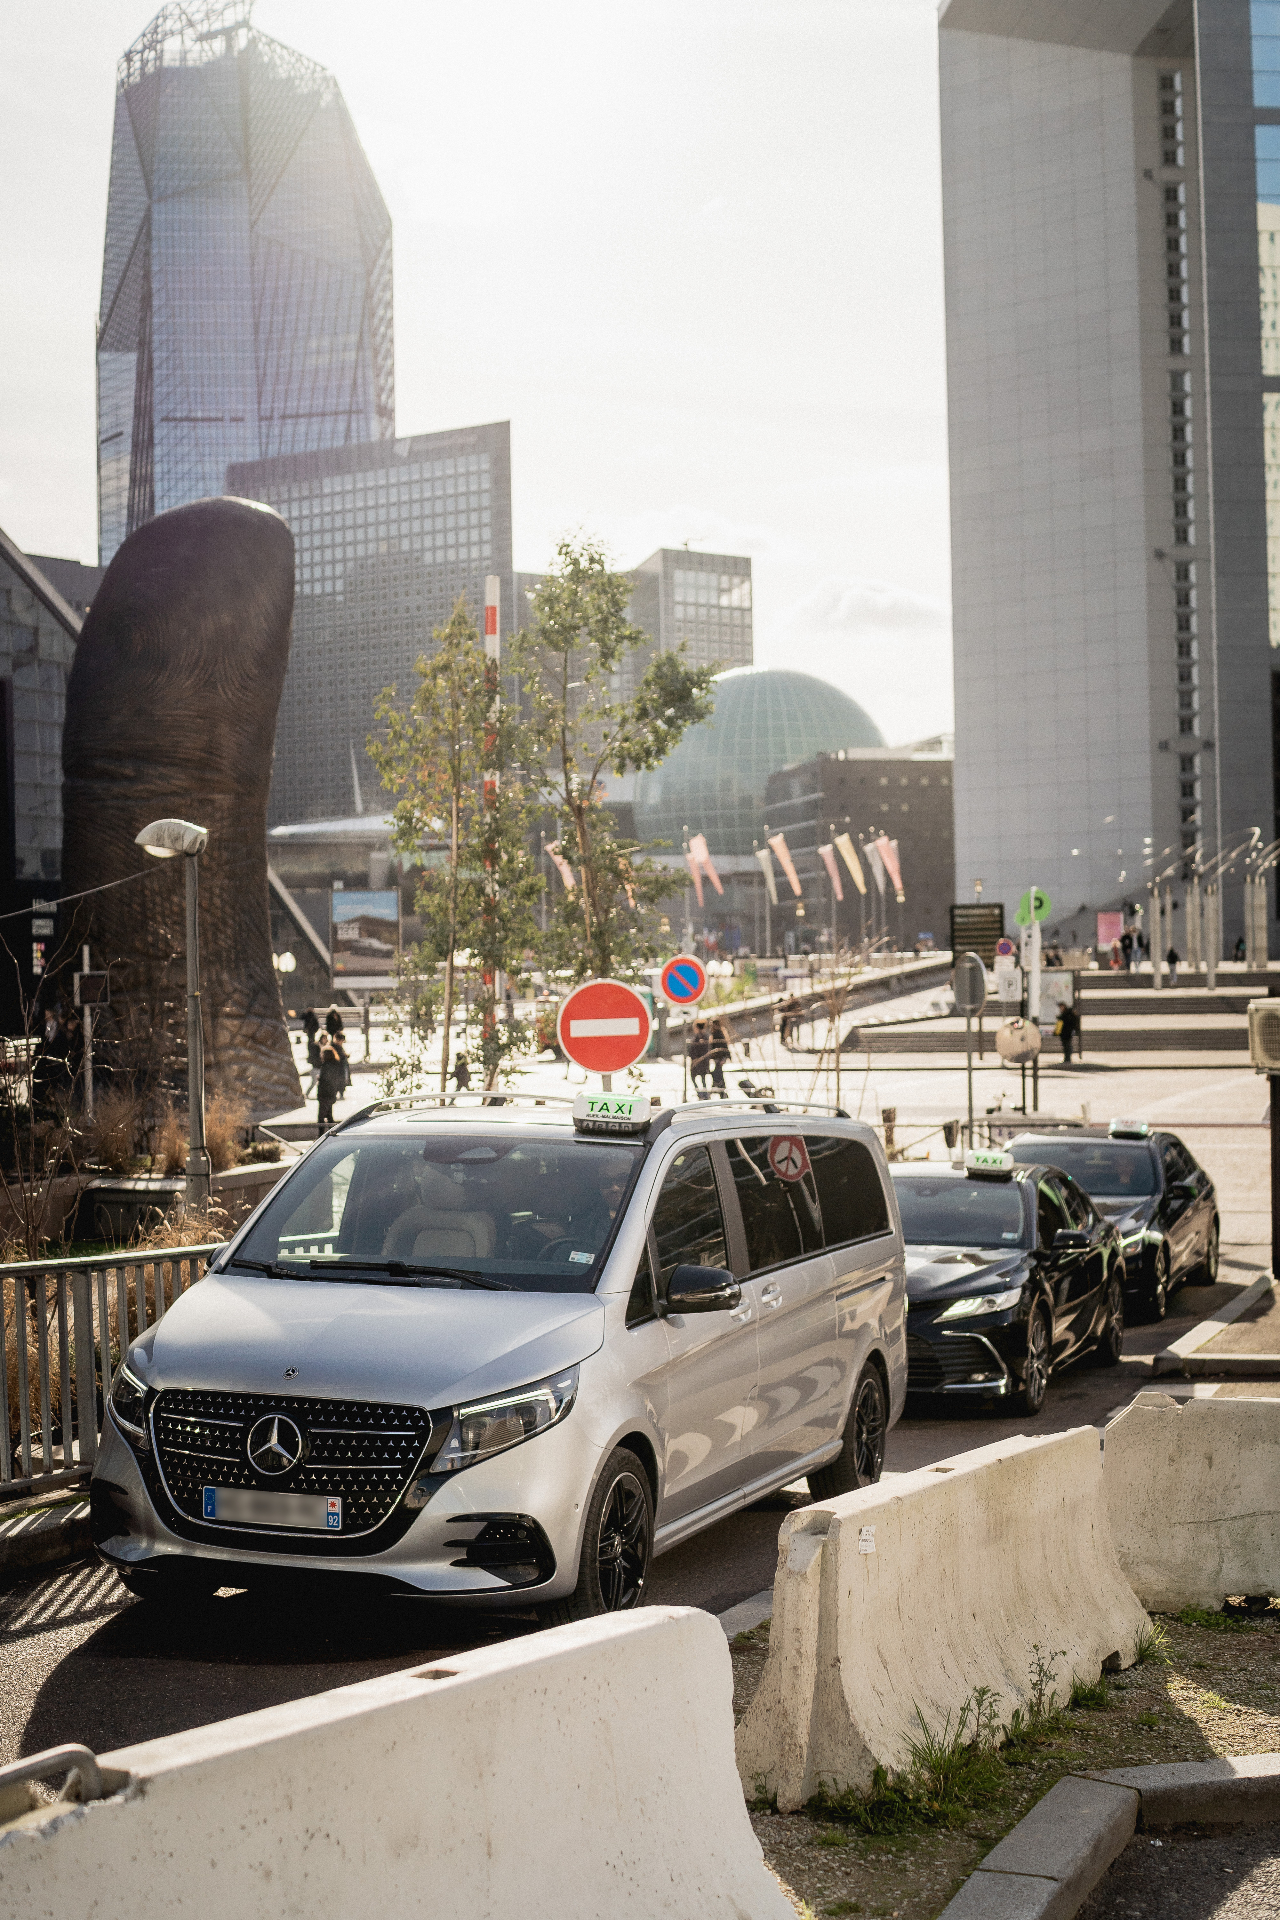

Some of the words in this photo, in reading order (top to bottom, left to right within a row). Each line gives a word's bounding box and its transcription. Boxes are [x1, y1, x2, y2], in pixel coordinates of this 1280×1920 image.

[587, 1101, 633, 1116] TAXI
[975, 1156, 1003, 1167] TAXI
[207, 1505, 212, 1513] F
[328, 1515, 339, 1527] 92
